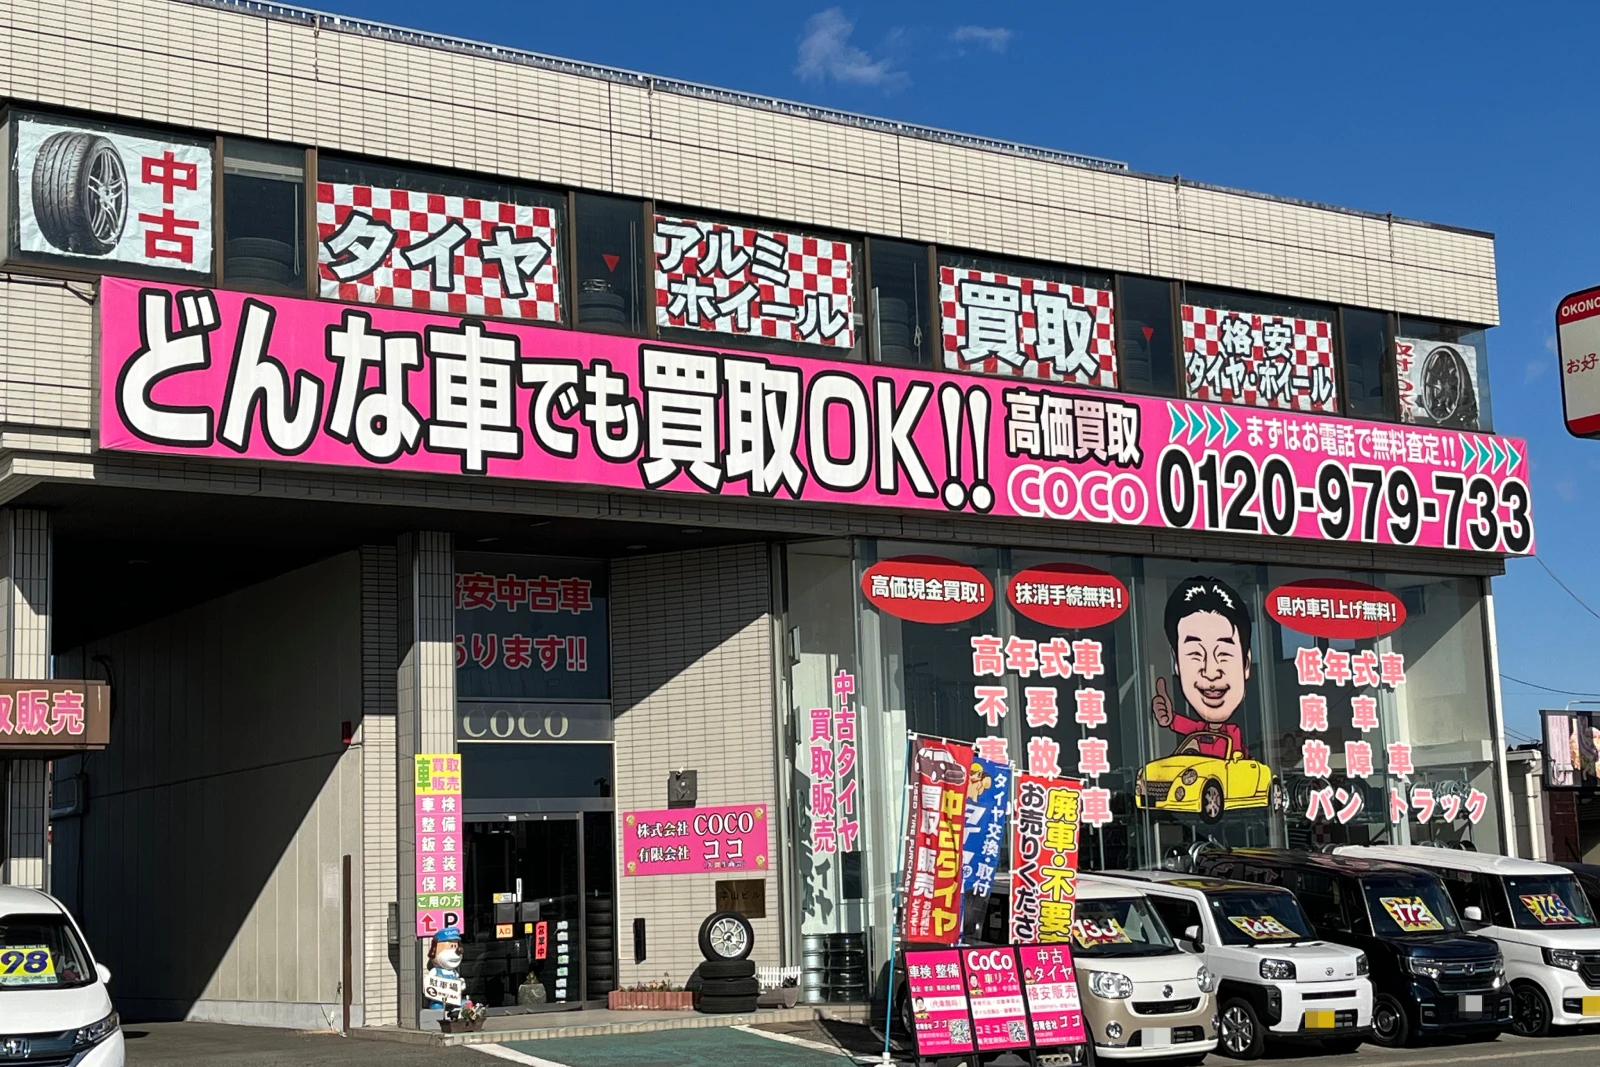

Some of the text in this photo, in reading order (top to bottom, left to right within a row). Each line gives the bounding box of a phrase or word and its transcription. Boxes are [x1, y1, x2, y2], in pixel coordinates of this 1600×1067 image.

[138, 151, 200, 264] 中古
[323, 209, 552, 298] タイヤ
[654, 219, 790, 288] アルミ
[667, 279, 849, 339] ホイール
[957, 279, 1100, 379] 買取
[1220, 315, 1294, 363] 格安
[1186, 348, 1334, 404] タイヤ・ホイール
[1566, 352, 1600, 375] お好
[1002, 387, 1145, 469] 高価買取
[1245, 415, 1458, 469] まずはお電話で無料査定!!
[1006, 462, 1151, 526] COCO
[1155, 443, 1534, 554] 0120-979-733
[870, 574, 986, 603] 高価現金買取!
[1015, 582, 1123, 609] 抹消手続無料!
[1275, 596, 1398, 622] 県内車引上げ無料!
[970, 635, 1105, 679] 高年式車
[1294, 647, 1406, 688] 低年式車
[462, 709, 569, 738] COCO
[1299, 693, 1379, 732] 廃車
[416, 757, 431, 792] 車
[432, 757, 460, 773] 買取
[833, 669, 859, 852] 中古タイヤ
[431, 776, 460, 791] 販売
[808, 707, 837, 854] 買取販売
[421, 796, 457, 812] 車検
[1306, 785, 1489, 825] バン トラック
[421, 816, 457, 833] 整備
[636, 812, 754, 839] 株式会社 COCO
[421, 855, 457, 873] 塗装
[637, 838, 744, 863] 有限会社 ココ
[931, 789, 965, 937] 中古タイヤ
[421, 875, 457, 892] 保険
[416, 895, 462, 909] ご用の方
[1393, 903, 1431, 922] 172
[443, 911, 459, 929] P
[1241, 919, 1286, 935] 148
[0, 950, 49, 974] 98
[1036, 947, 1063, 965] 中古
[1034, 965, 1073, 981] タイヤ
